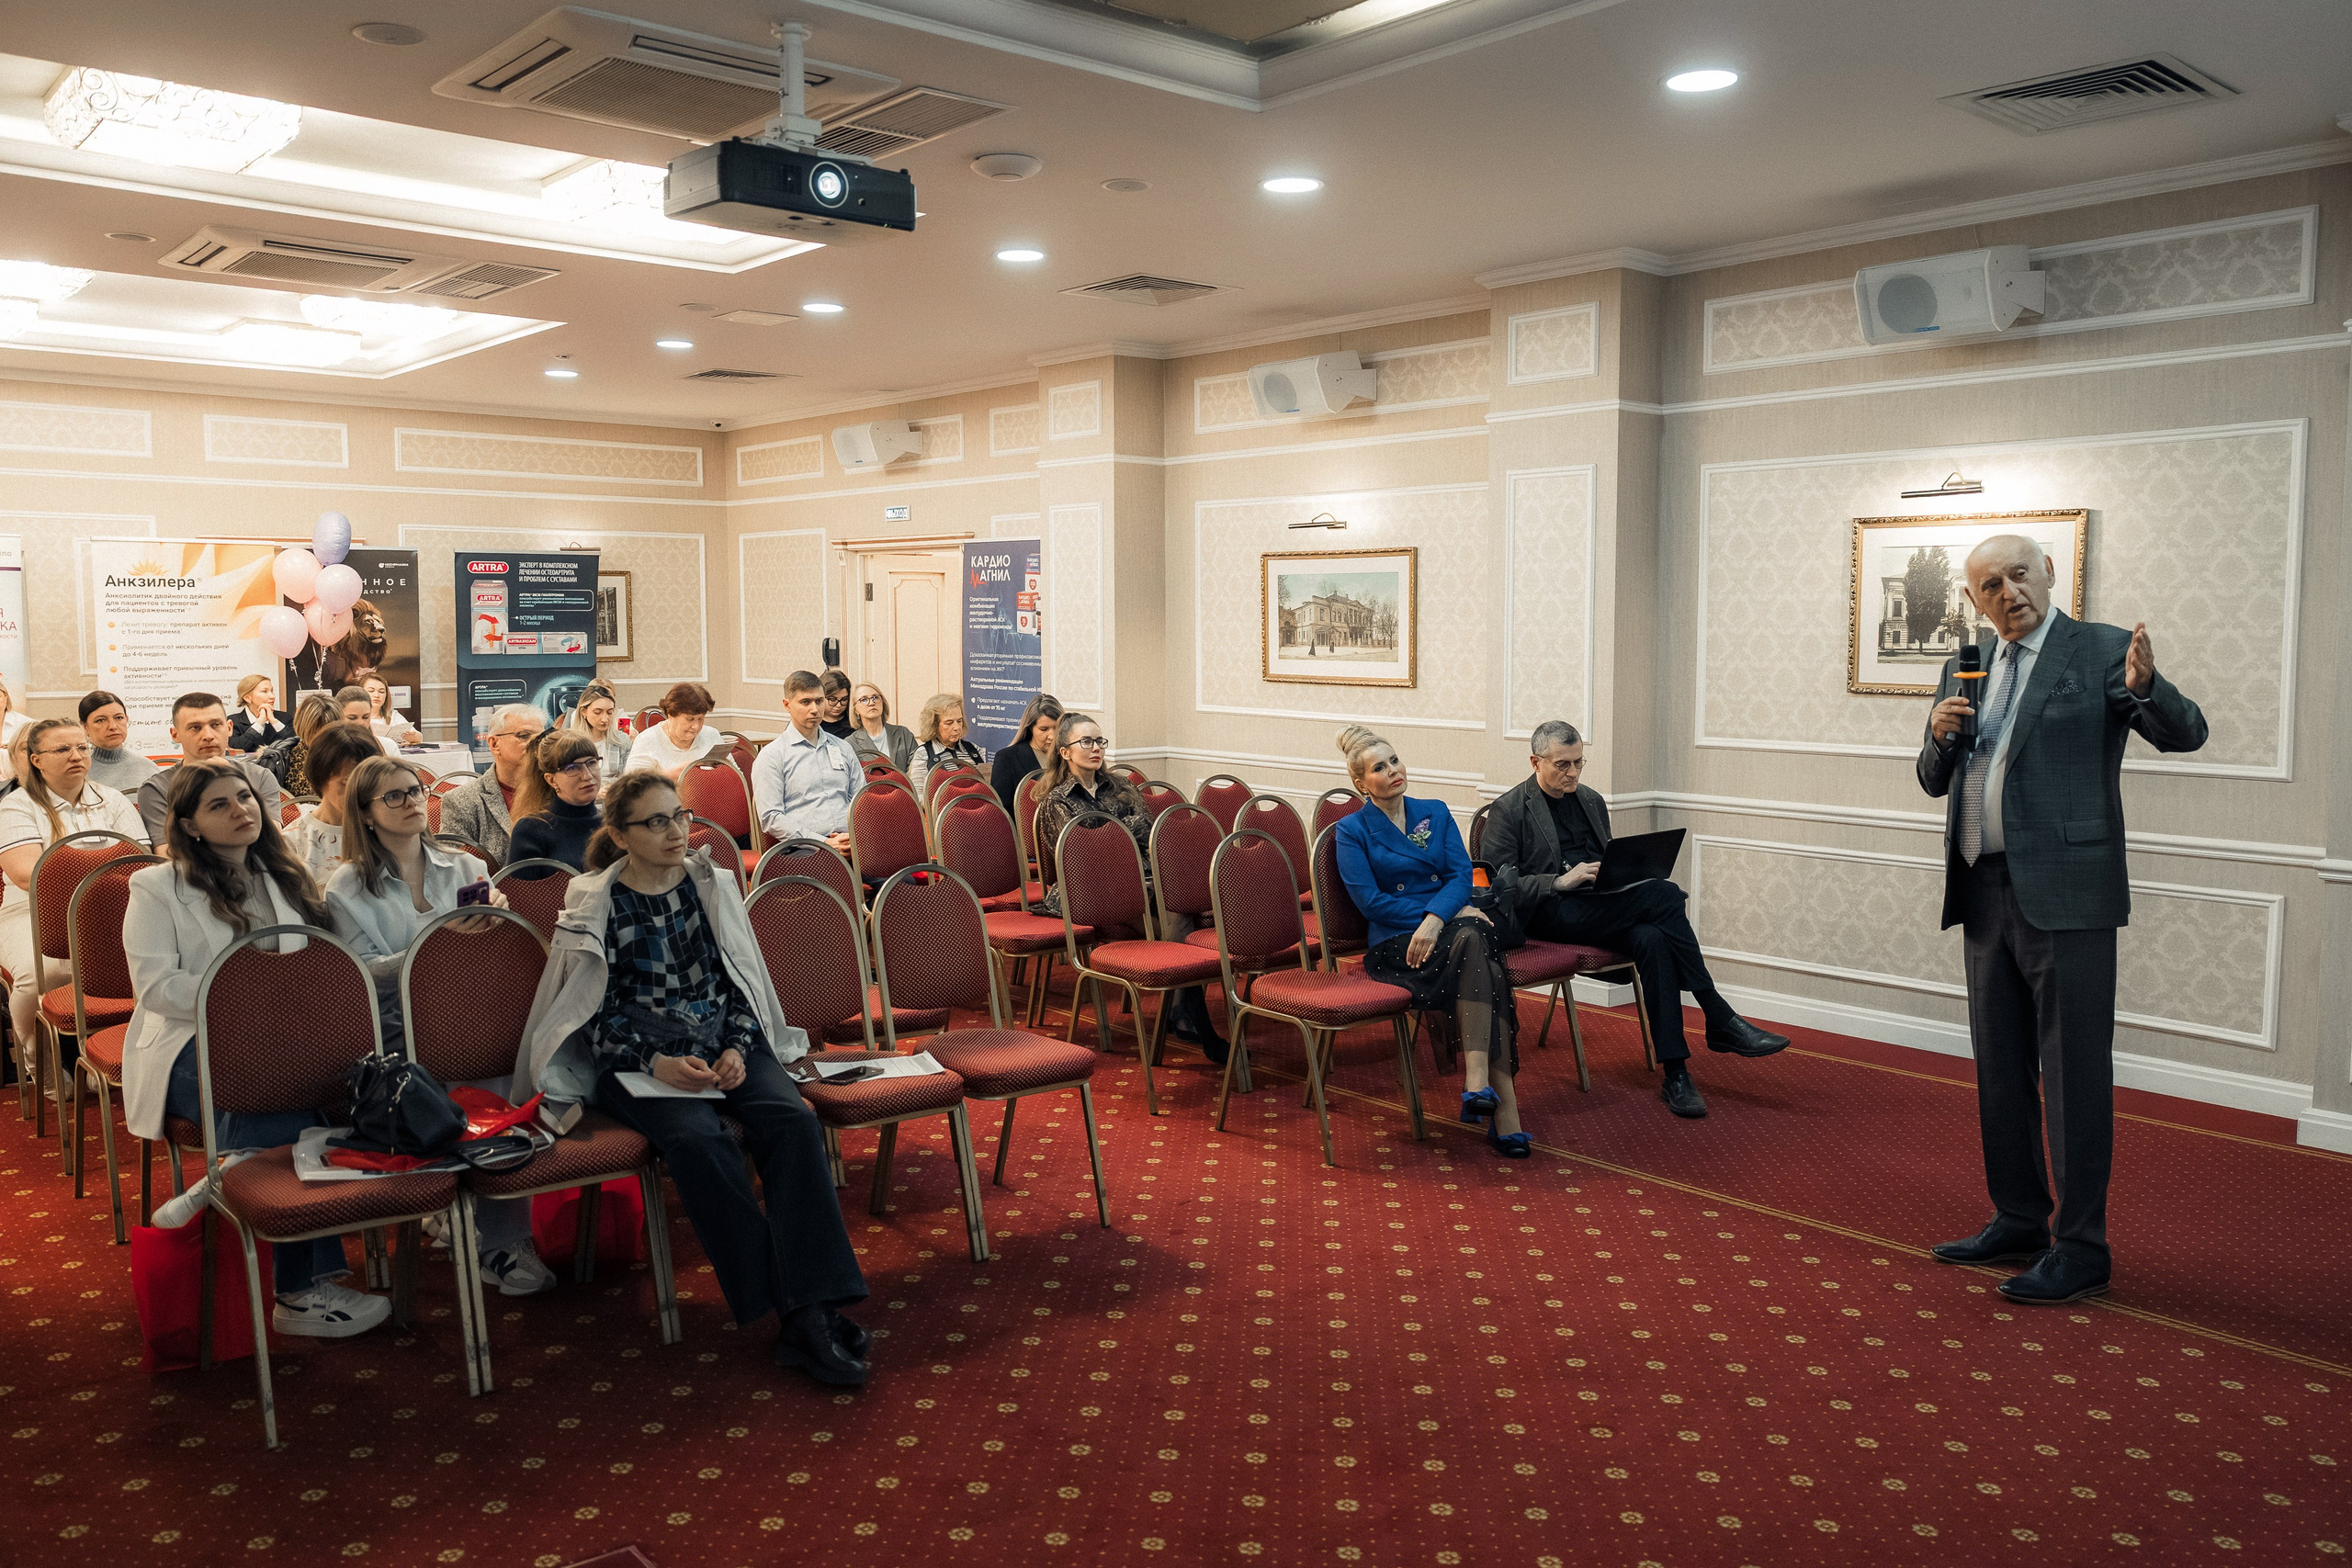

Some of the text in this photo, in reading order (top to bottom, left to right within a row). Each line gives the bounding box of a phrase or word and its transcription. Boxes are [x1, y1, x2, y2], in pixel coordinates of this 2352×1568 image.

[471, 563, 503, 571] ARTRA
[970, 555, 1011, 569] КАРДИО
[970, 569, 1011, 590] МАГНИЛ
[127, 720, 162, 728] устите
